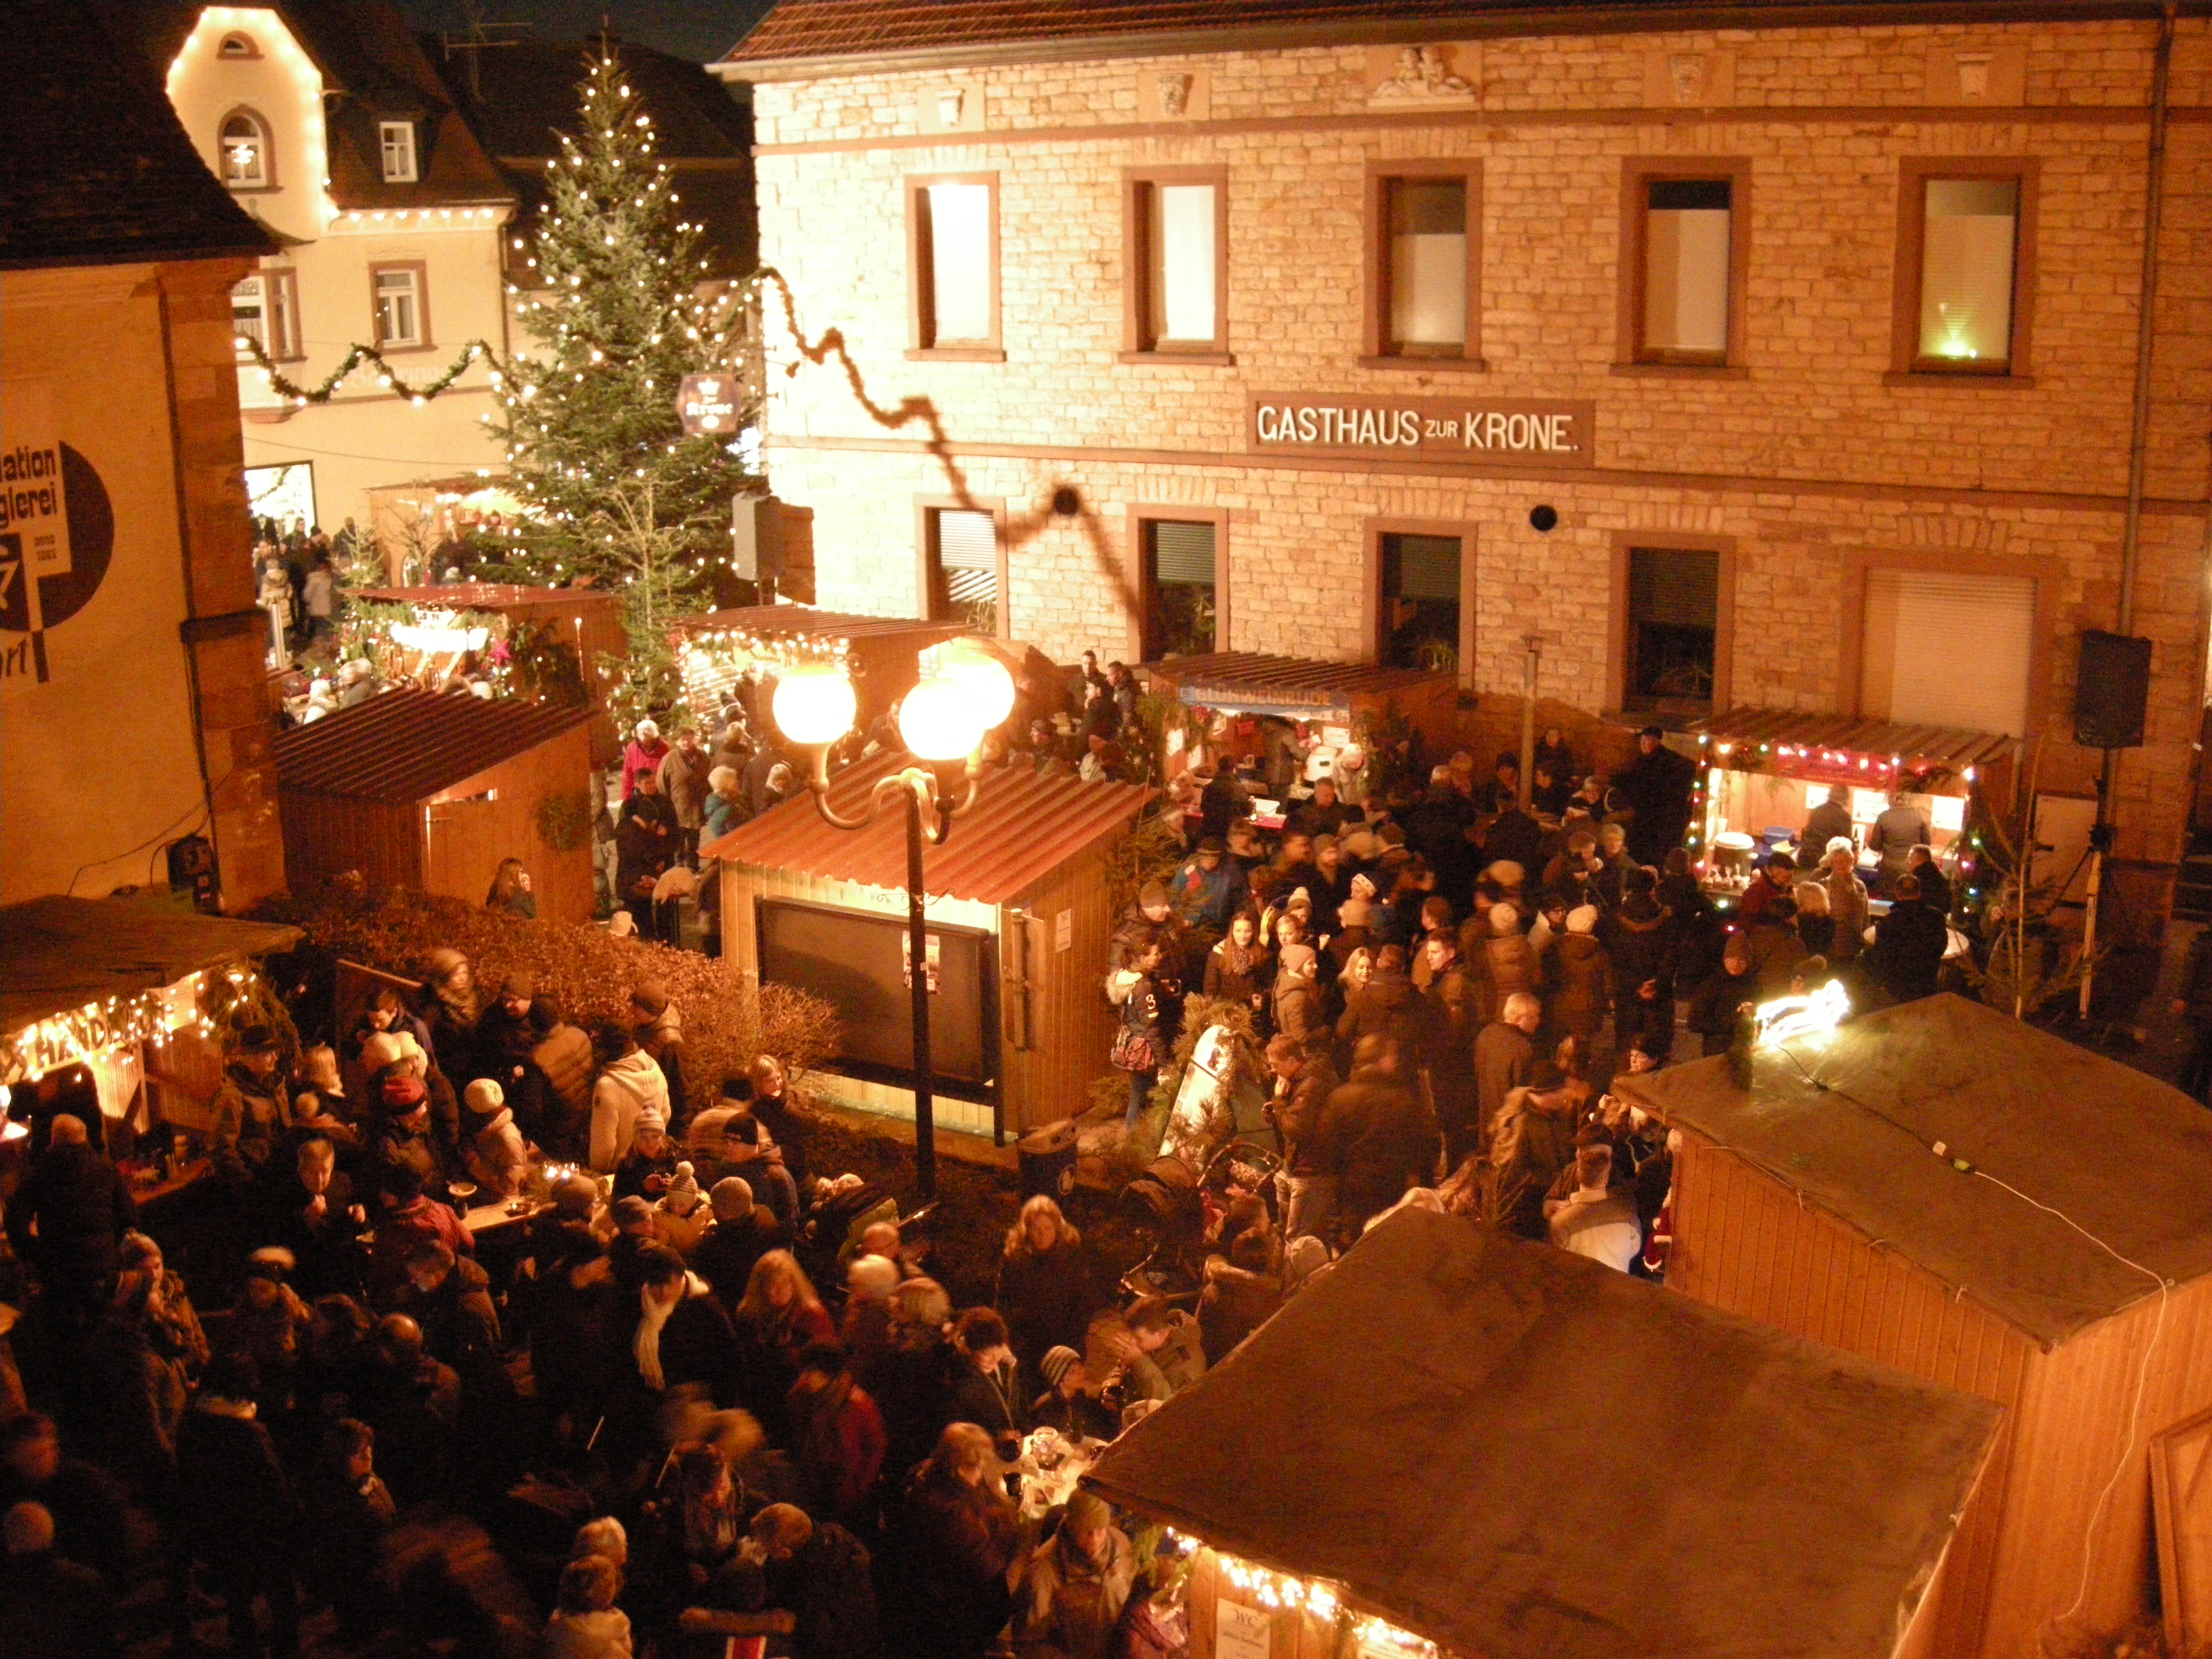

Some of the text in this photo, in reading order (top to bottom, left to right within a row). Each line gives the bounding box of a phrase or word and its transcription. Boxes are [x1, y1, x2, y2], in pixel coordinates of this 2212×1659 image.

[1258, 405, 1580, 451] GASTHAUS ZUR KRONE.
